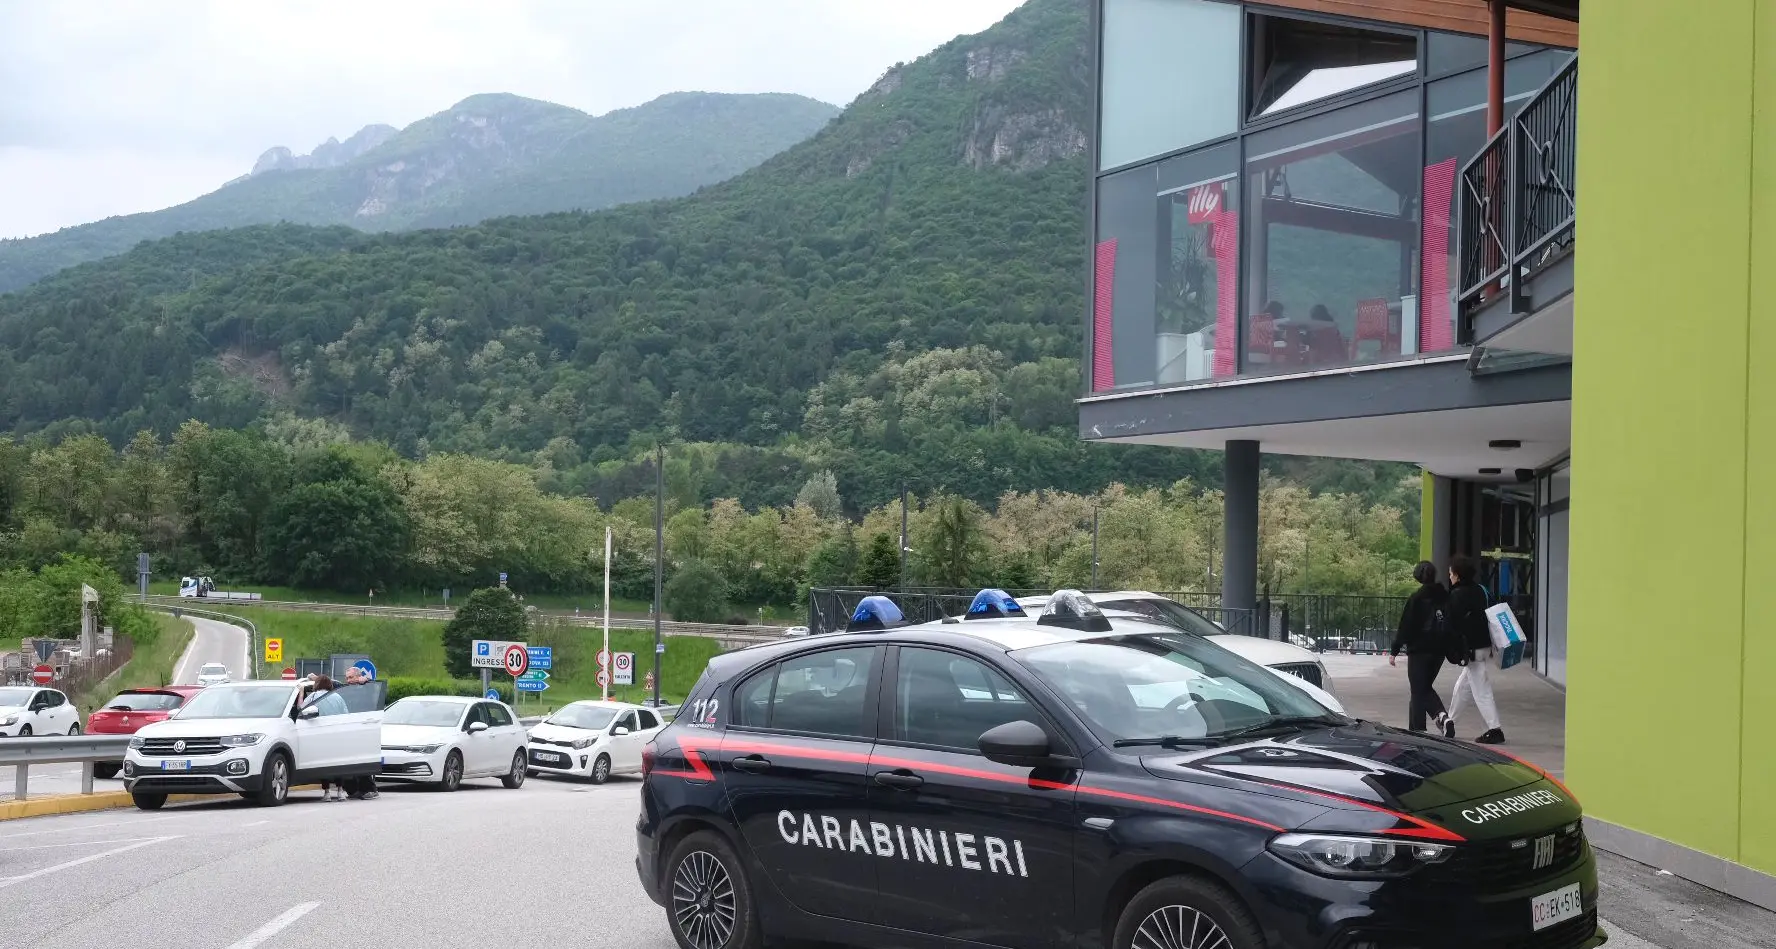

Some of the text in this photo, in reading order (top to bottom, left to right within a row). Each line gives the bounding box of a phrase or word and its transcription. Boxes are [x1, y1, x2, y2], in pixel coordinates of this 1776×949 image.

[1189, 185, 1219, 218] illy
[473, 658, 505, 666] INGRESS
[509, 653, 521, 667] 30
[618, 658, 627, 666] 30
[692, 698, 719, 723] 112
[1461, 789, 1563, 824] CARABINIERI
[778, 810, 1028, 877] CARABINIERI
[1533, 833, 1556, 870] FIAT
[1564, 890, 1581, 912] 518
